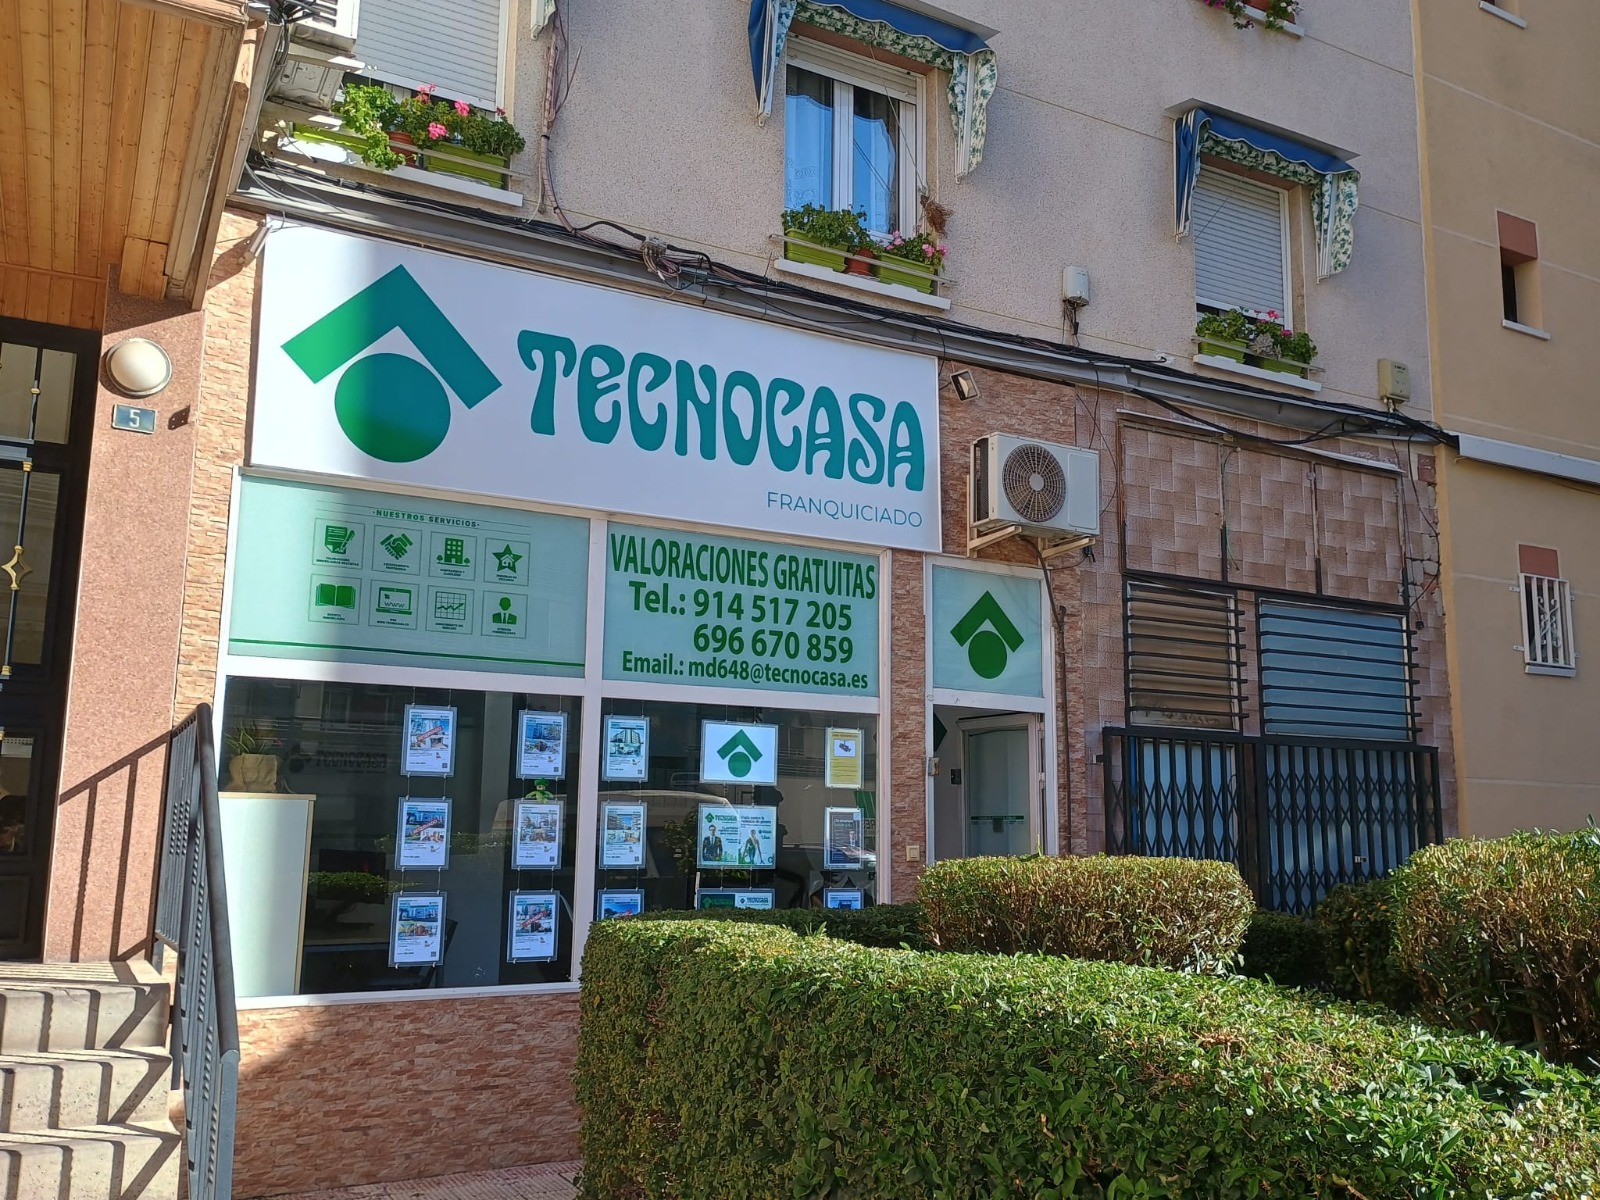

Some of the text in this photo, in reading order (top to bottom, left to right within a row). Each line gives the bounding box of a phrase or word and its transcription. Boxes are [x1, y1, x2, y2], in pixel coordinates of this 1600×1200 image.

[129, 409, 140, 427] 5
[517, 329, 925, 491] TECNOCASA
[767, 491, 922, 528] FRANQUICIADO
[610, 533, 876, 600] VALORACIONES GRATUITAS
[628, 580, 852, 631] Tel.: 914 517 205
[693, 623, 853, 664] 696 670 859
[622, 650, 868, 689] Email.: md648@tecnocasa.es
